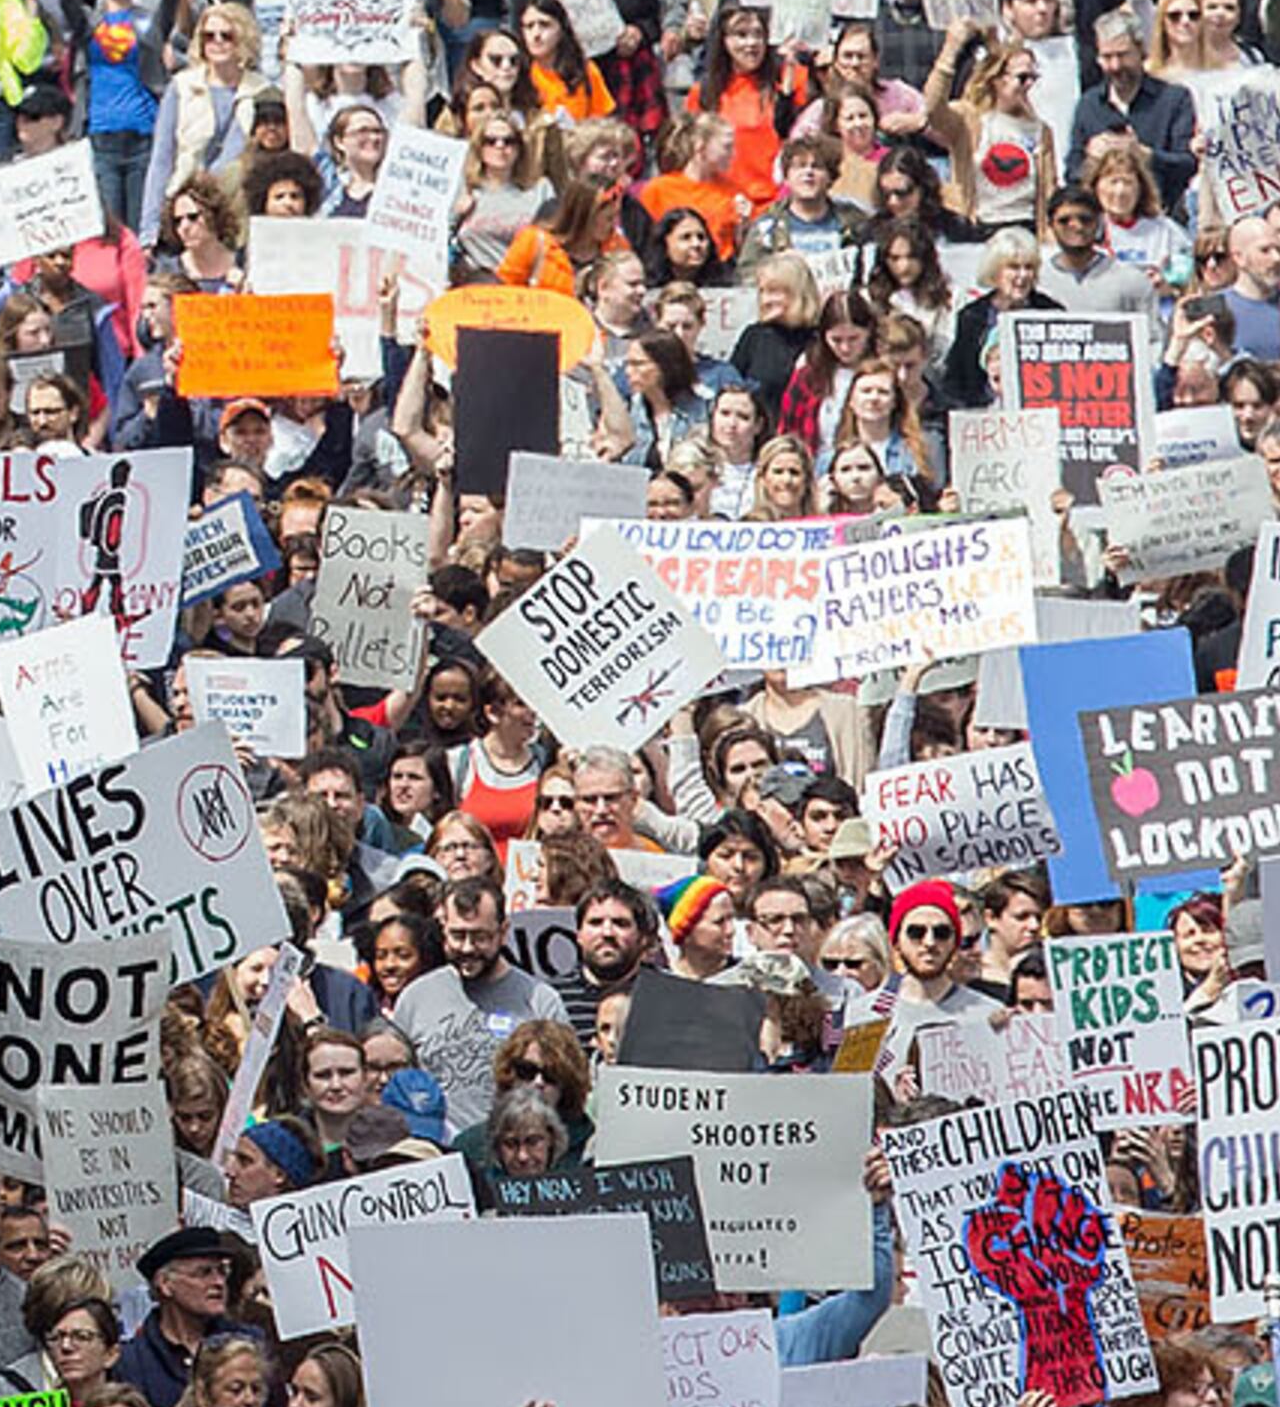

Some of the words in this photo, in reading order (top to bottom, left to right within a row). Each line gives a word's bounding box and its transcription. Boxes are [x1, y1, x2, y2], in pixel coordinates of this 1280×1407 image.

[1220, 148, 1277, 173] ARE
[1022, 362, 1053, 396] IS
[1061, 362, 1132, 396] NOT
[324, 514, 426, 563] Books
[345, 575, 398, 611] Not
[520, 559, 599, 643] STOP
[540, 581, 658, 691] DOMESTIC
[565, 610, 684, 712] TERRORISM
[878, 769, 958, 811] FEAR
[971, 758, 1034, 794] HAS
[41, 853, 160, 943] OVER
[618, 1083, 729, 1114] STUDENT
[690, 1121, 818, 1148] SHOOTERS
[719, 1159, 772, 1187] NOT
[262, 1202, 341, 1262] GUN
[341, 1174, 469, 1224] CONTROL
